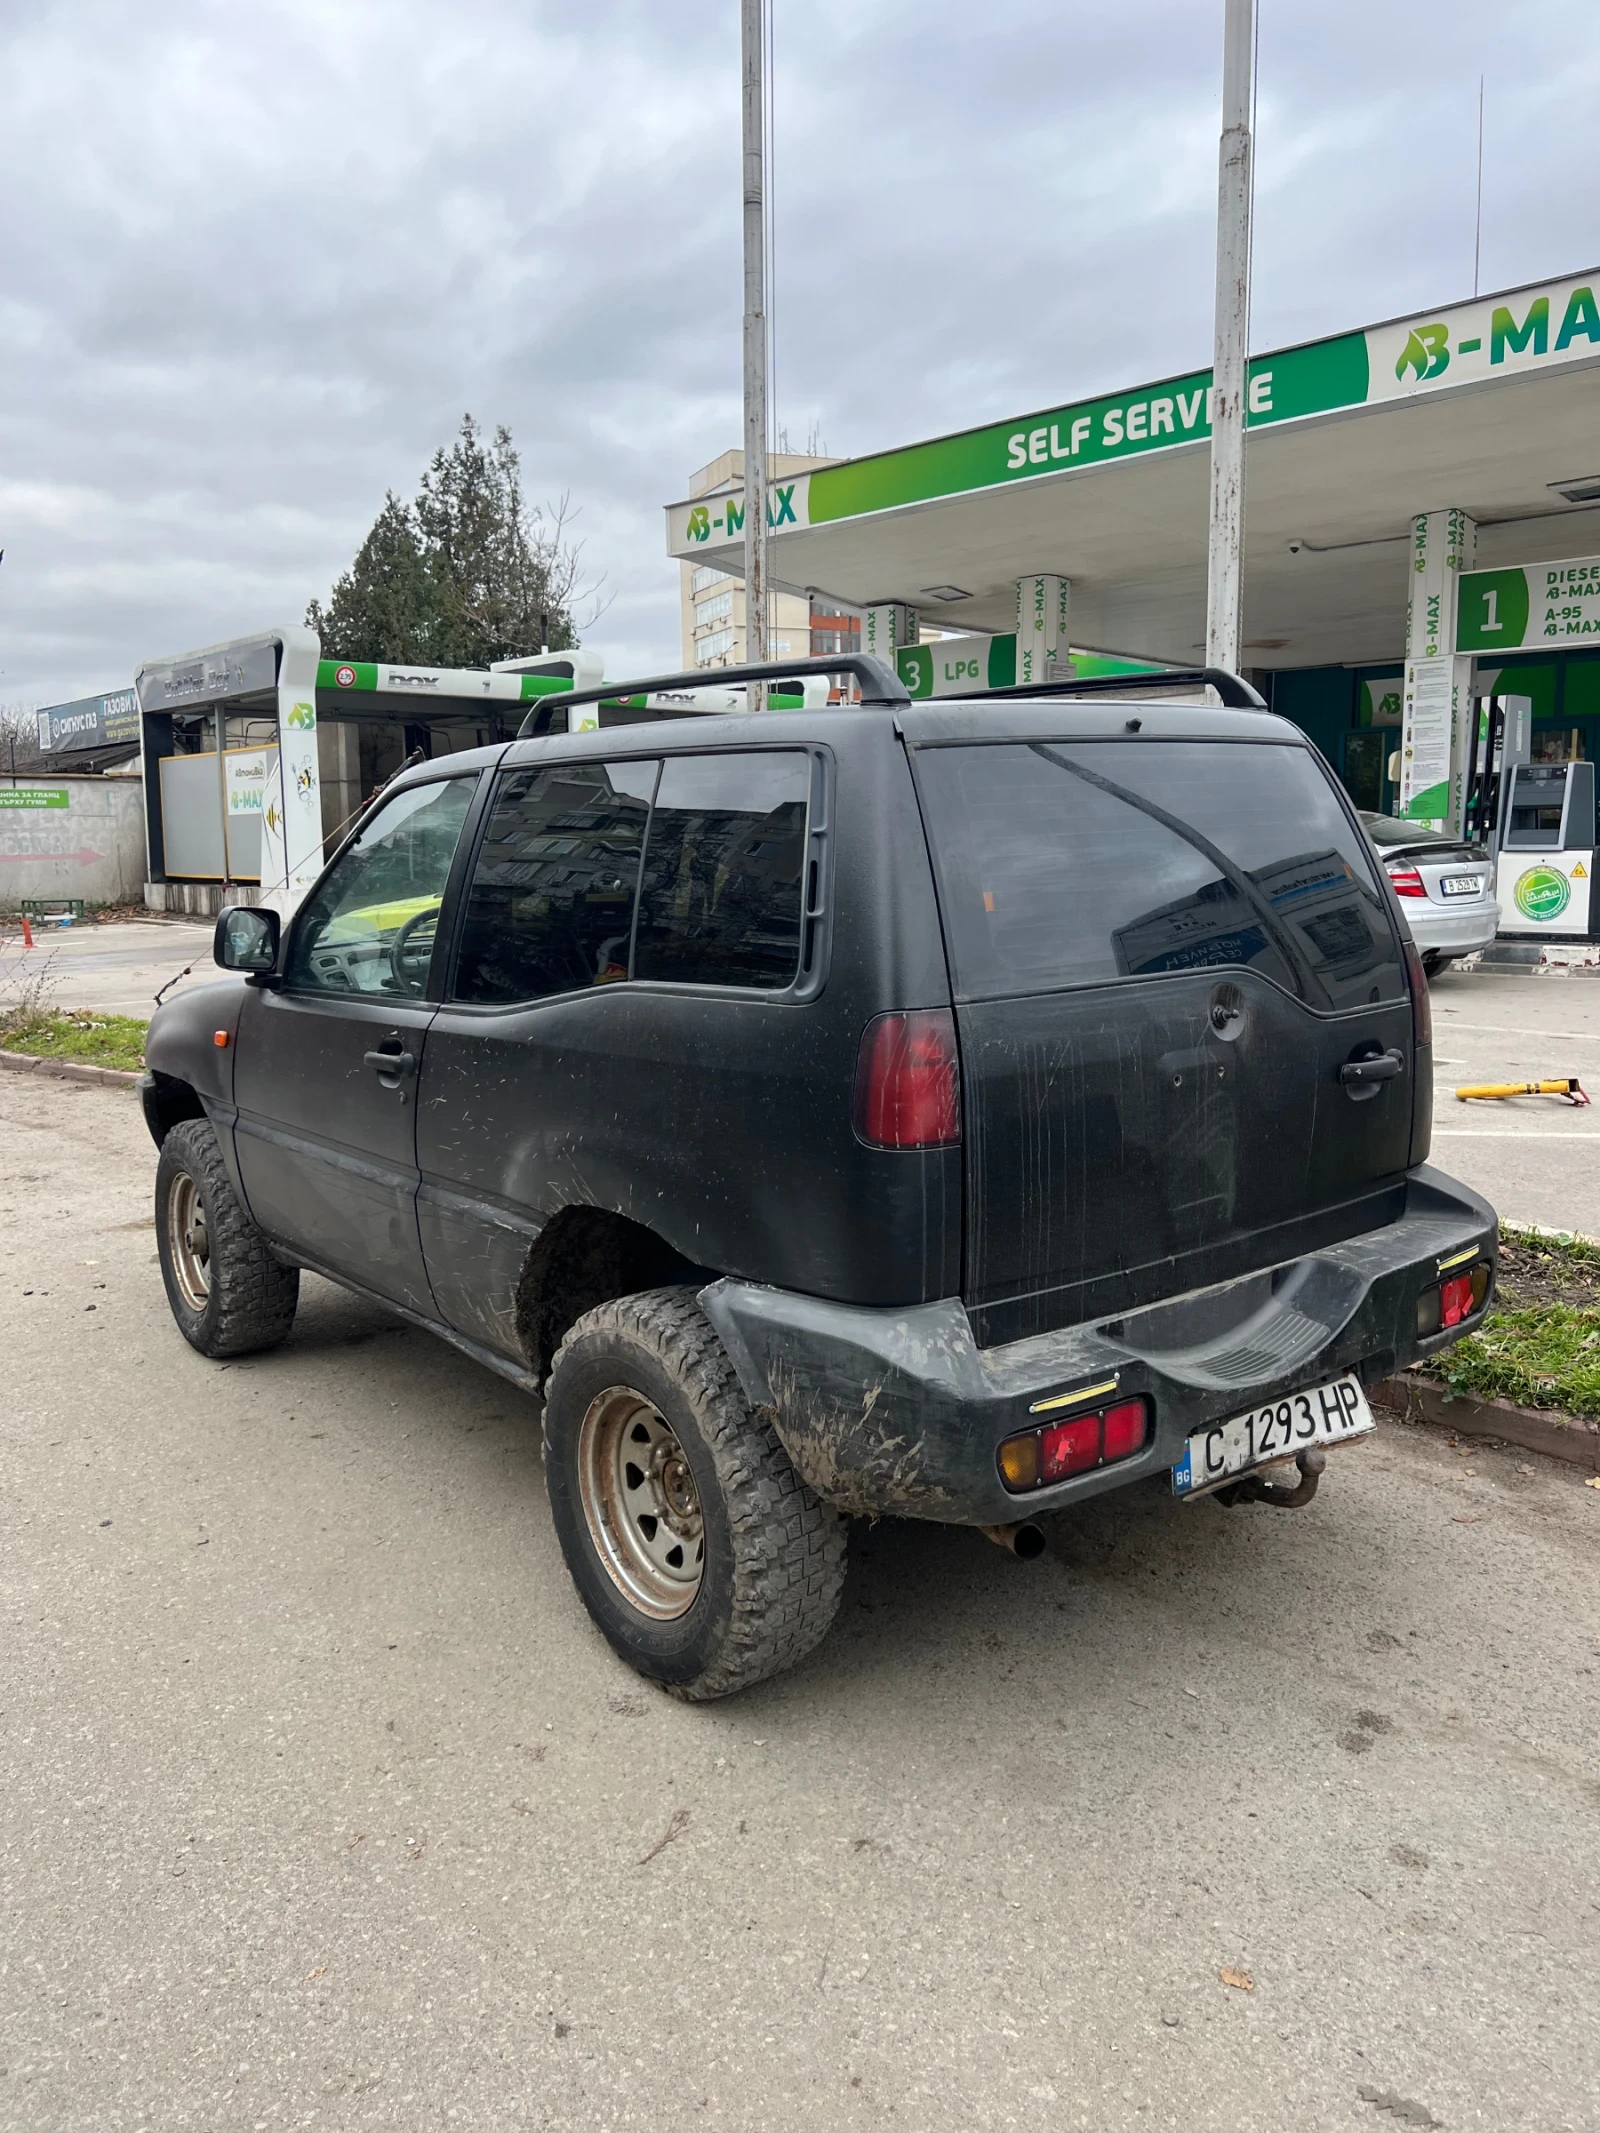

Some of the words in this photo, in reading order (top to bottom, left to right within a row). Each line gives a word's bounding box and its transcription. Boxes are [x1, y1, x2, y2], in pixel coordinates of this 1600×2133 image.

[1007, 417, 1091, 469] SELF
[1102, 372, 1273, 446] SERVIE
[1480, 590, 1503, 632] 1
[1545, 606, 1582, 621] A-95
[339, 673, 352, 681] 2.75
[905, 660, 921, 692] 3
[945, 659, 979, 681] LPG
[482, 680, 491, 694] 1
[103, 694, 132, 717] ГАЗОВИ
[60, 714, 85, 735] СИГНУС
[85, 711, 98, 730] ГАЗ
[1205, 1427, 1225, 1472] C
[1245, 1395, 1316, 1457] 1293
[1318, 1382, 1359, 1433] HP
[1176, 1471, 1190, 1485] BG
